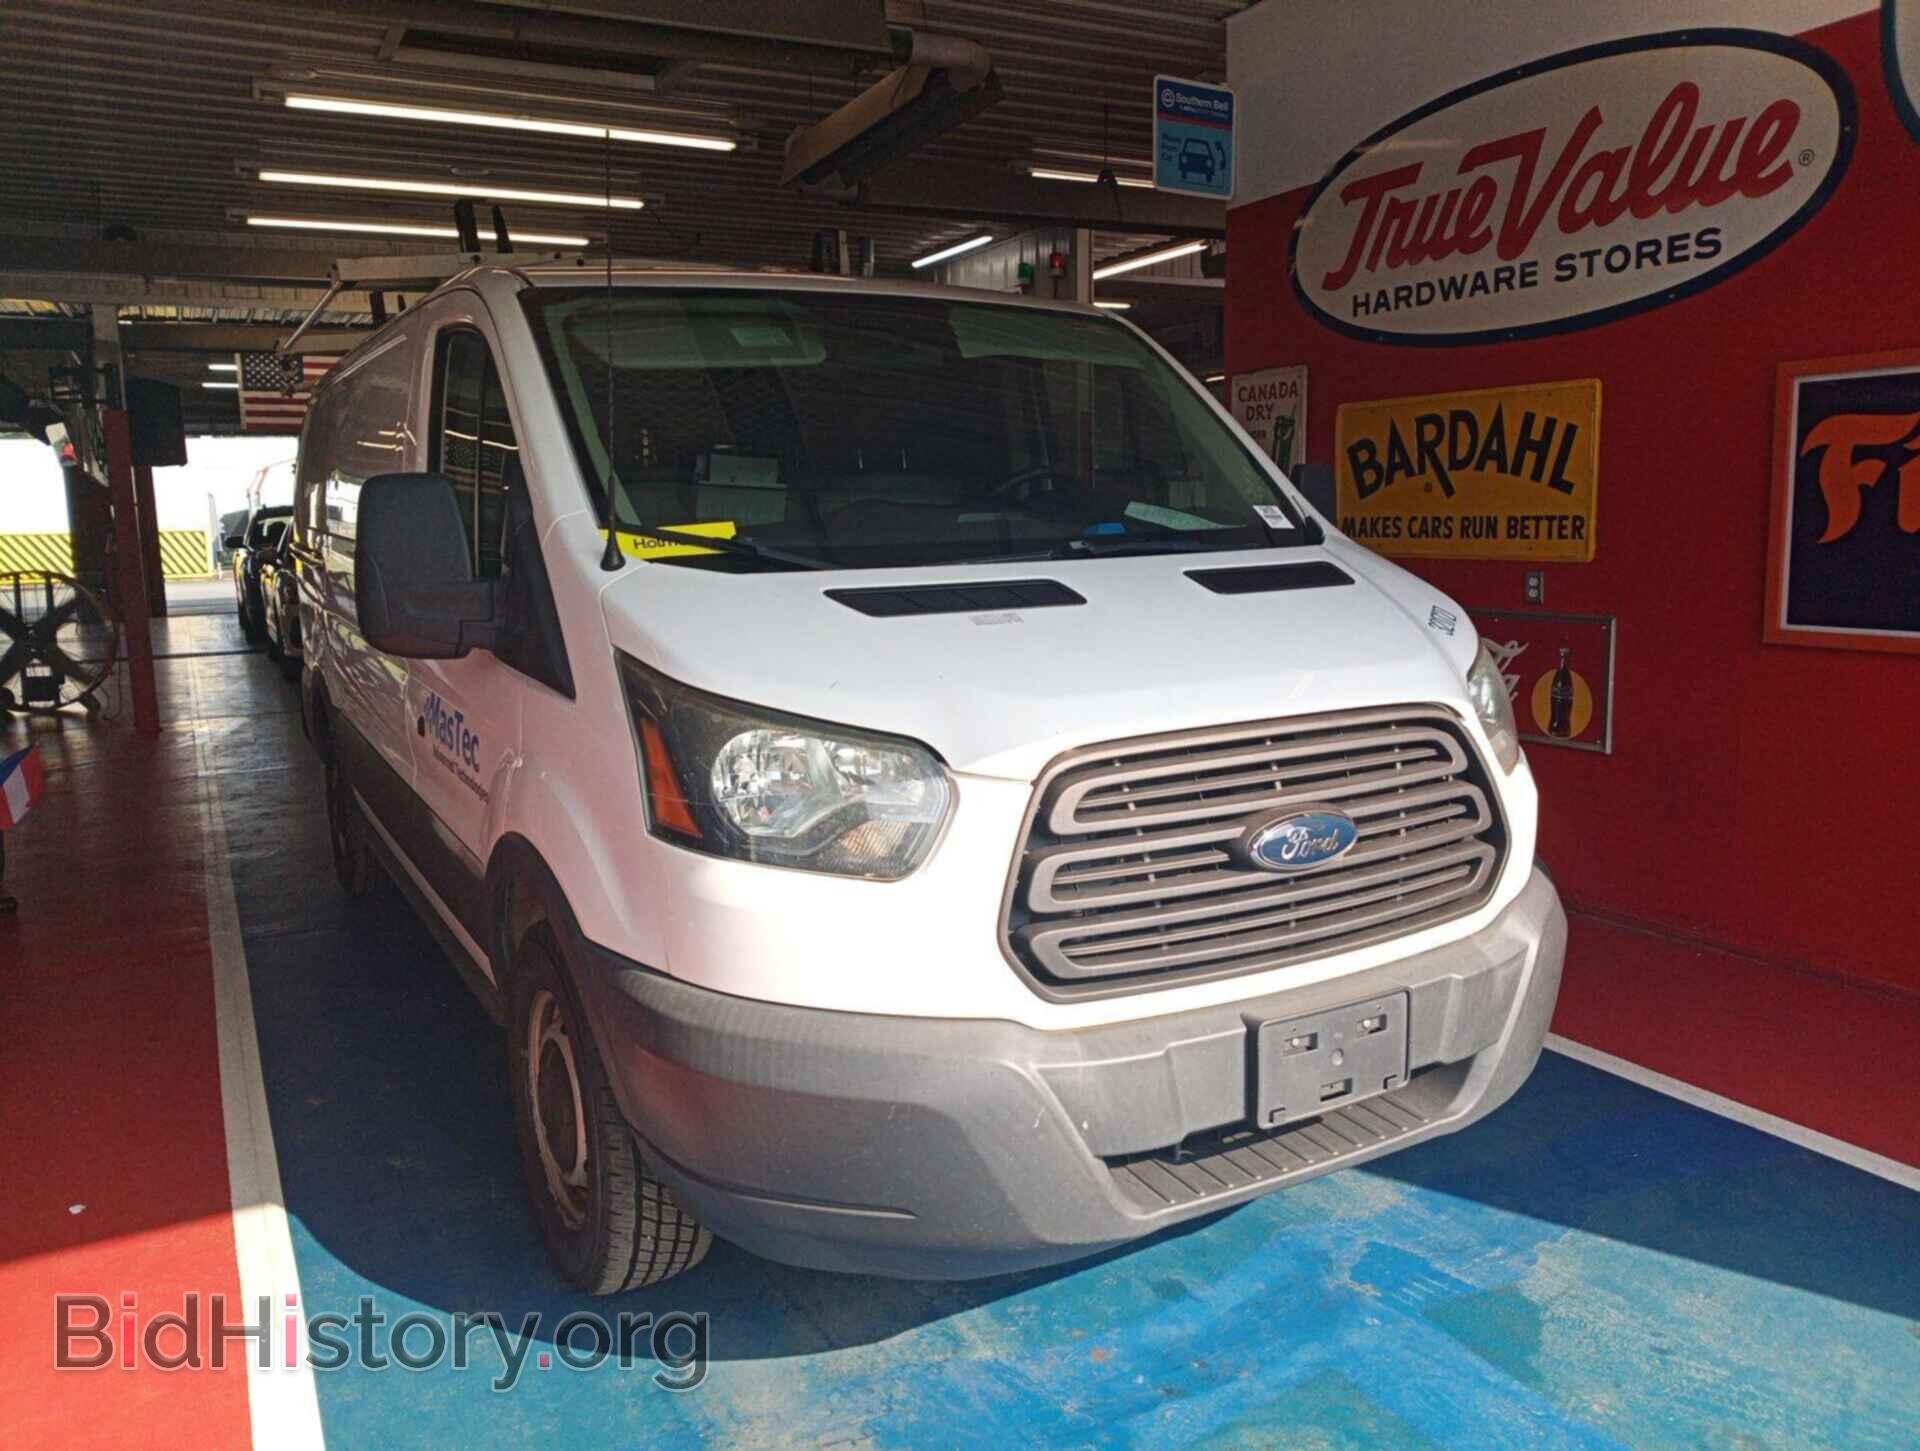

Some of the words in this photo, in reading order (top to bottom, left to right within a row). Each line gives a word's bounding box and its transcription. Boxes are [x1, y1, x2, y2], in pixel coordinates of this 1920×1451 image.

[1352, 260, 1539, 318] HARDWARE
[1554, 228, 1723, 282] STORES
[1238, 381, 1298, 402] CANADA
[1246, 402, 1274, 421] DRY
[1346, 401, 1579, 501] BARDAHL
[1342, 516, 1401, 542] MAKES
[1407, 515, 1454, 540] CARS
[1460, 515, 1498, 540] RUN
[1506, 515, 1585, 541] BETTER
[424, 691, 480, 774] MasTec
[1281, 825, 1339, 860] Ford
